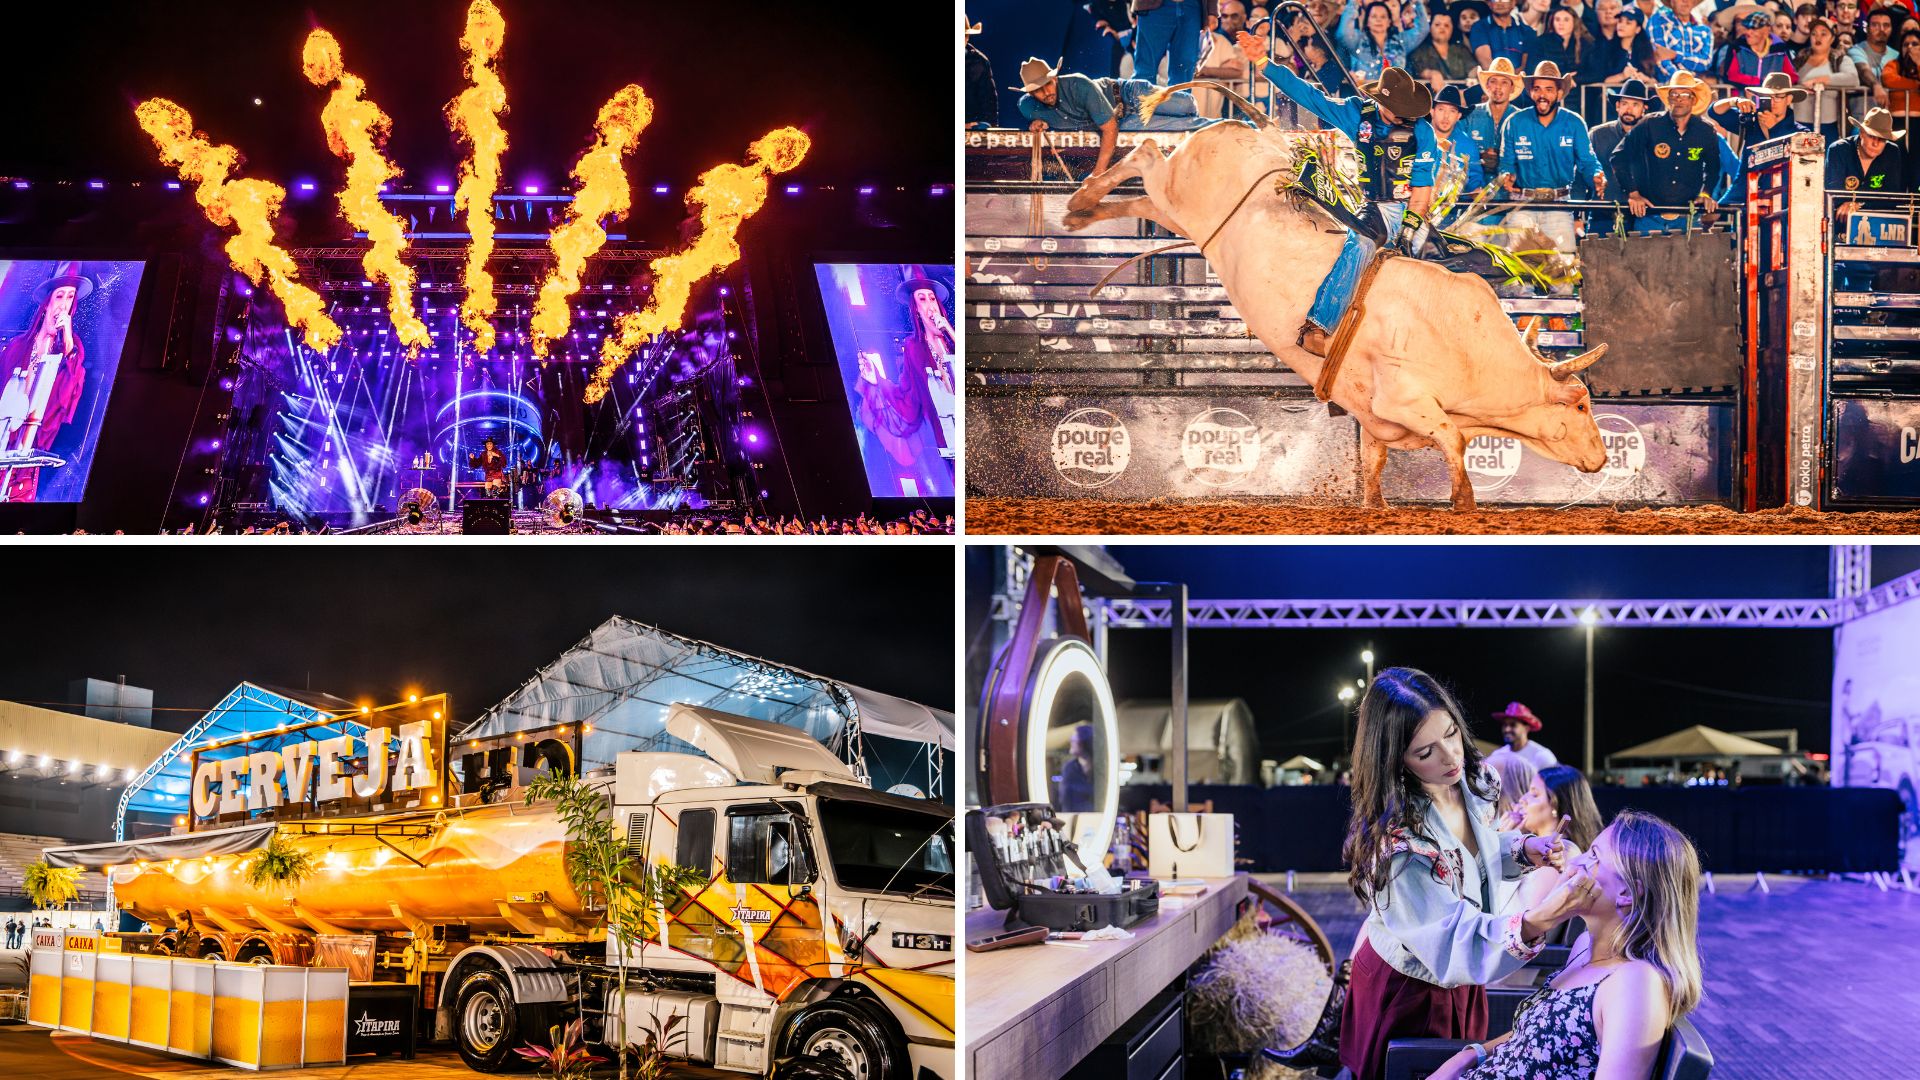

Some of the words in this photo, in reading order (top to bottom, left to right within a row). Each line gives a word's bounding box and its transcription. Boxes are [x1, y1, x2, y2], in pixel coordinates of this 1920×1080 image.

[1880, 223, 1906, 241] LNR
[1057, 429, 1124, 449] poupe
[1187, 429, 1256, 449] poupe
[1466, 435, 1515, 454] oupe
[1602, 435, 1639, 454] upe
[1800, 426, 1812, 457] petro
[1074, 448, 1114, 466] real
[1204, 446, 1243, 465] real
[1468, 450, 1505, 469] real
[193, 719, 438, 818] CERVEJA
[737, 910, 771, 920] ITAPIRA
[36, 934, 55, 947] CAIXA
[68, 937, 94, 950] CAIXA
[361, 1020, 400, 1032] ITAPIRA
